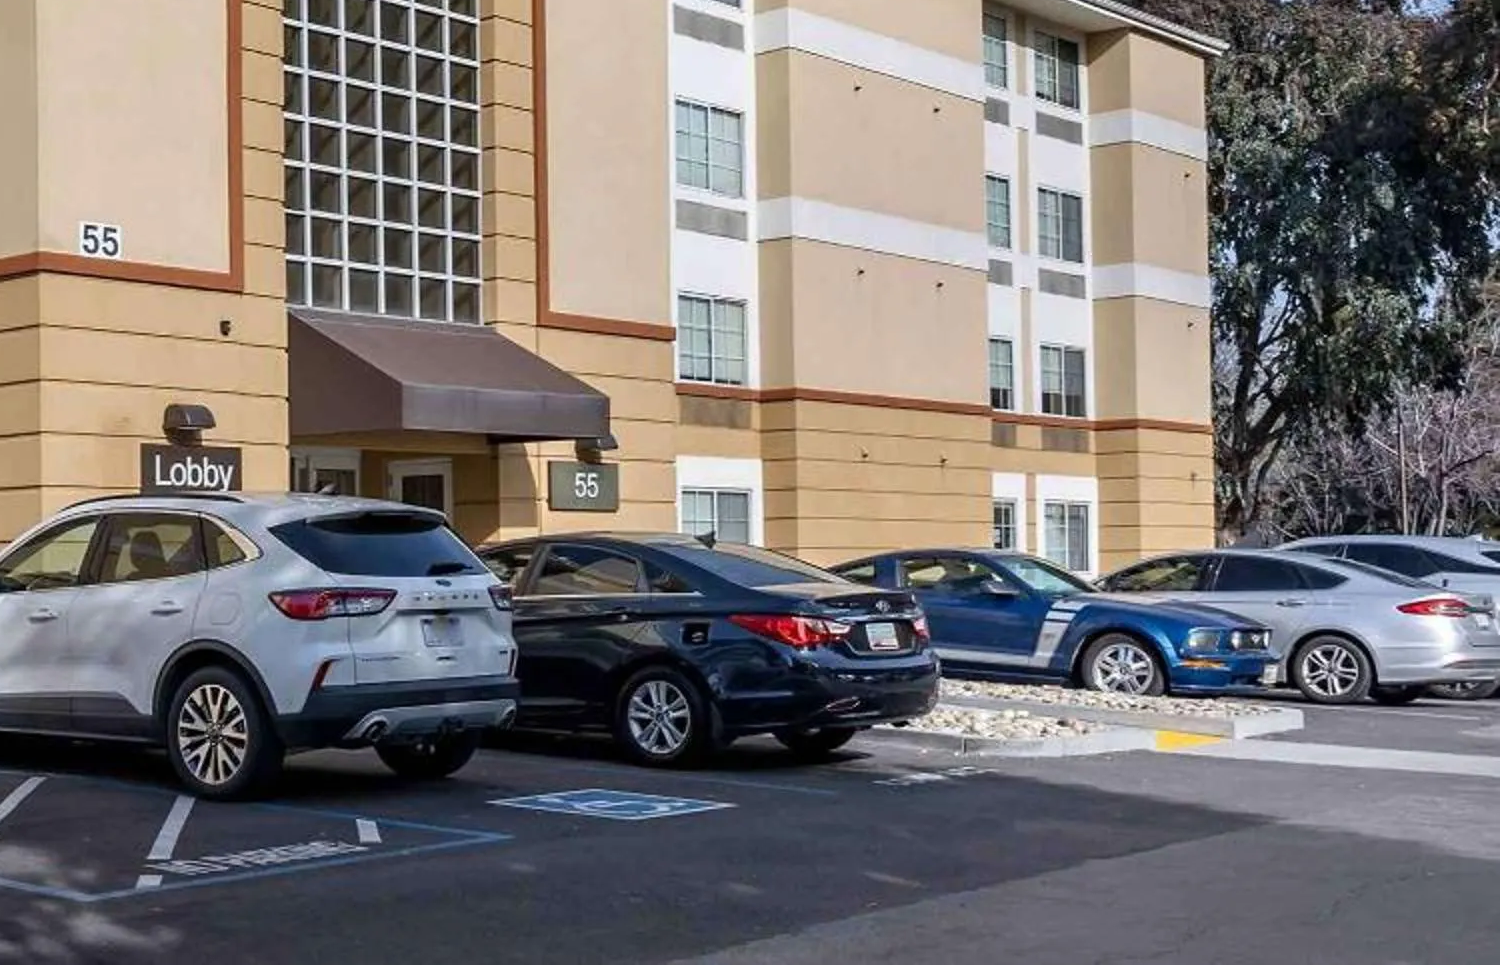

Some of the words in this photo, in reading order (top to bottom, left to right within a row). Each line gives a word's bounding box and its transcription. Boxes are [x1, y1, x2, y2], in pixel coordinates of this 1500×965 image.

[83, 224, 119, 257] 55
[155, 454, 234, 492] Lobby
[575, 472, 599, 498] 55
